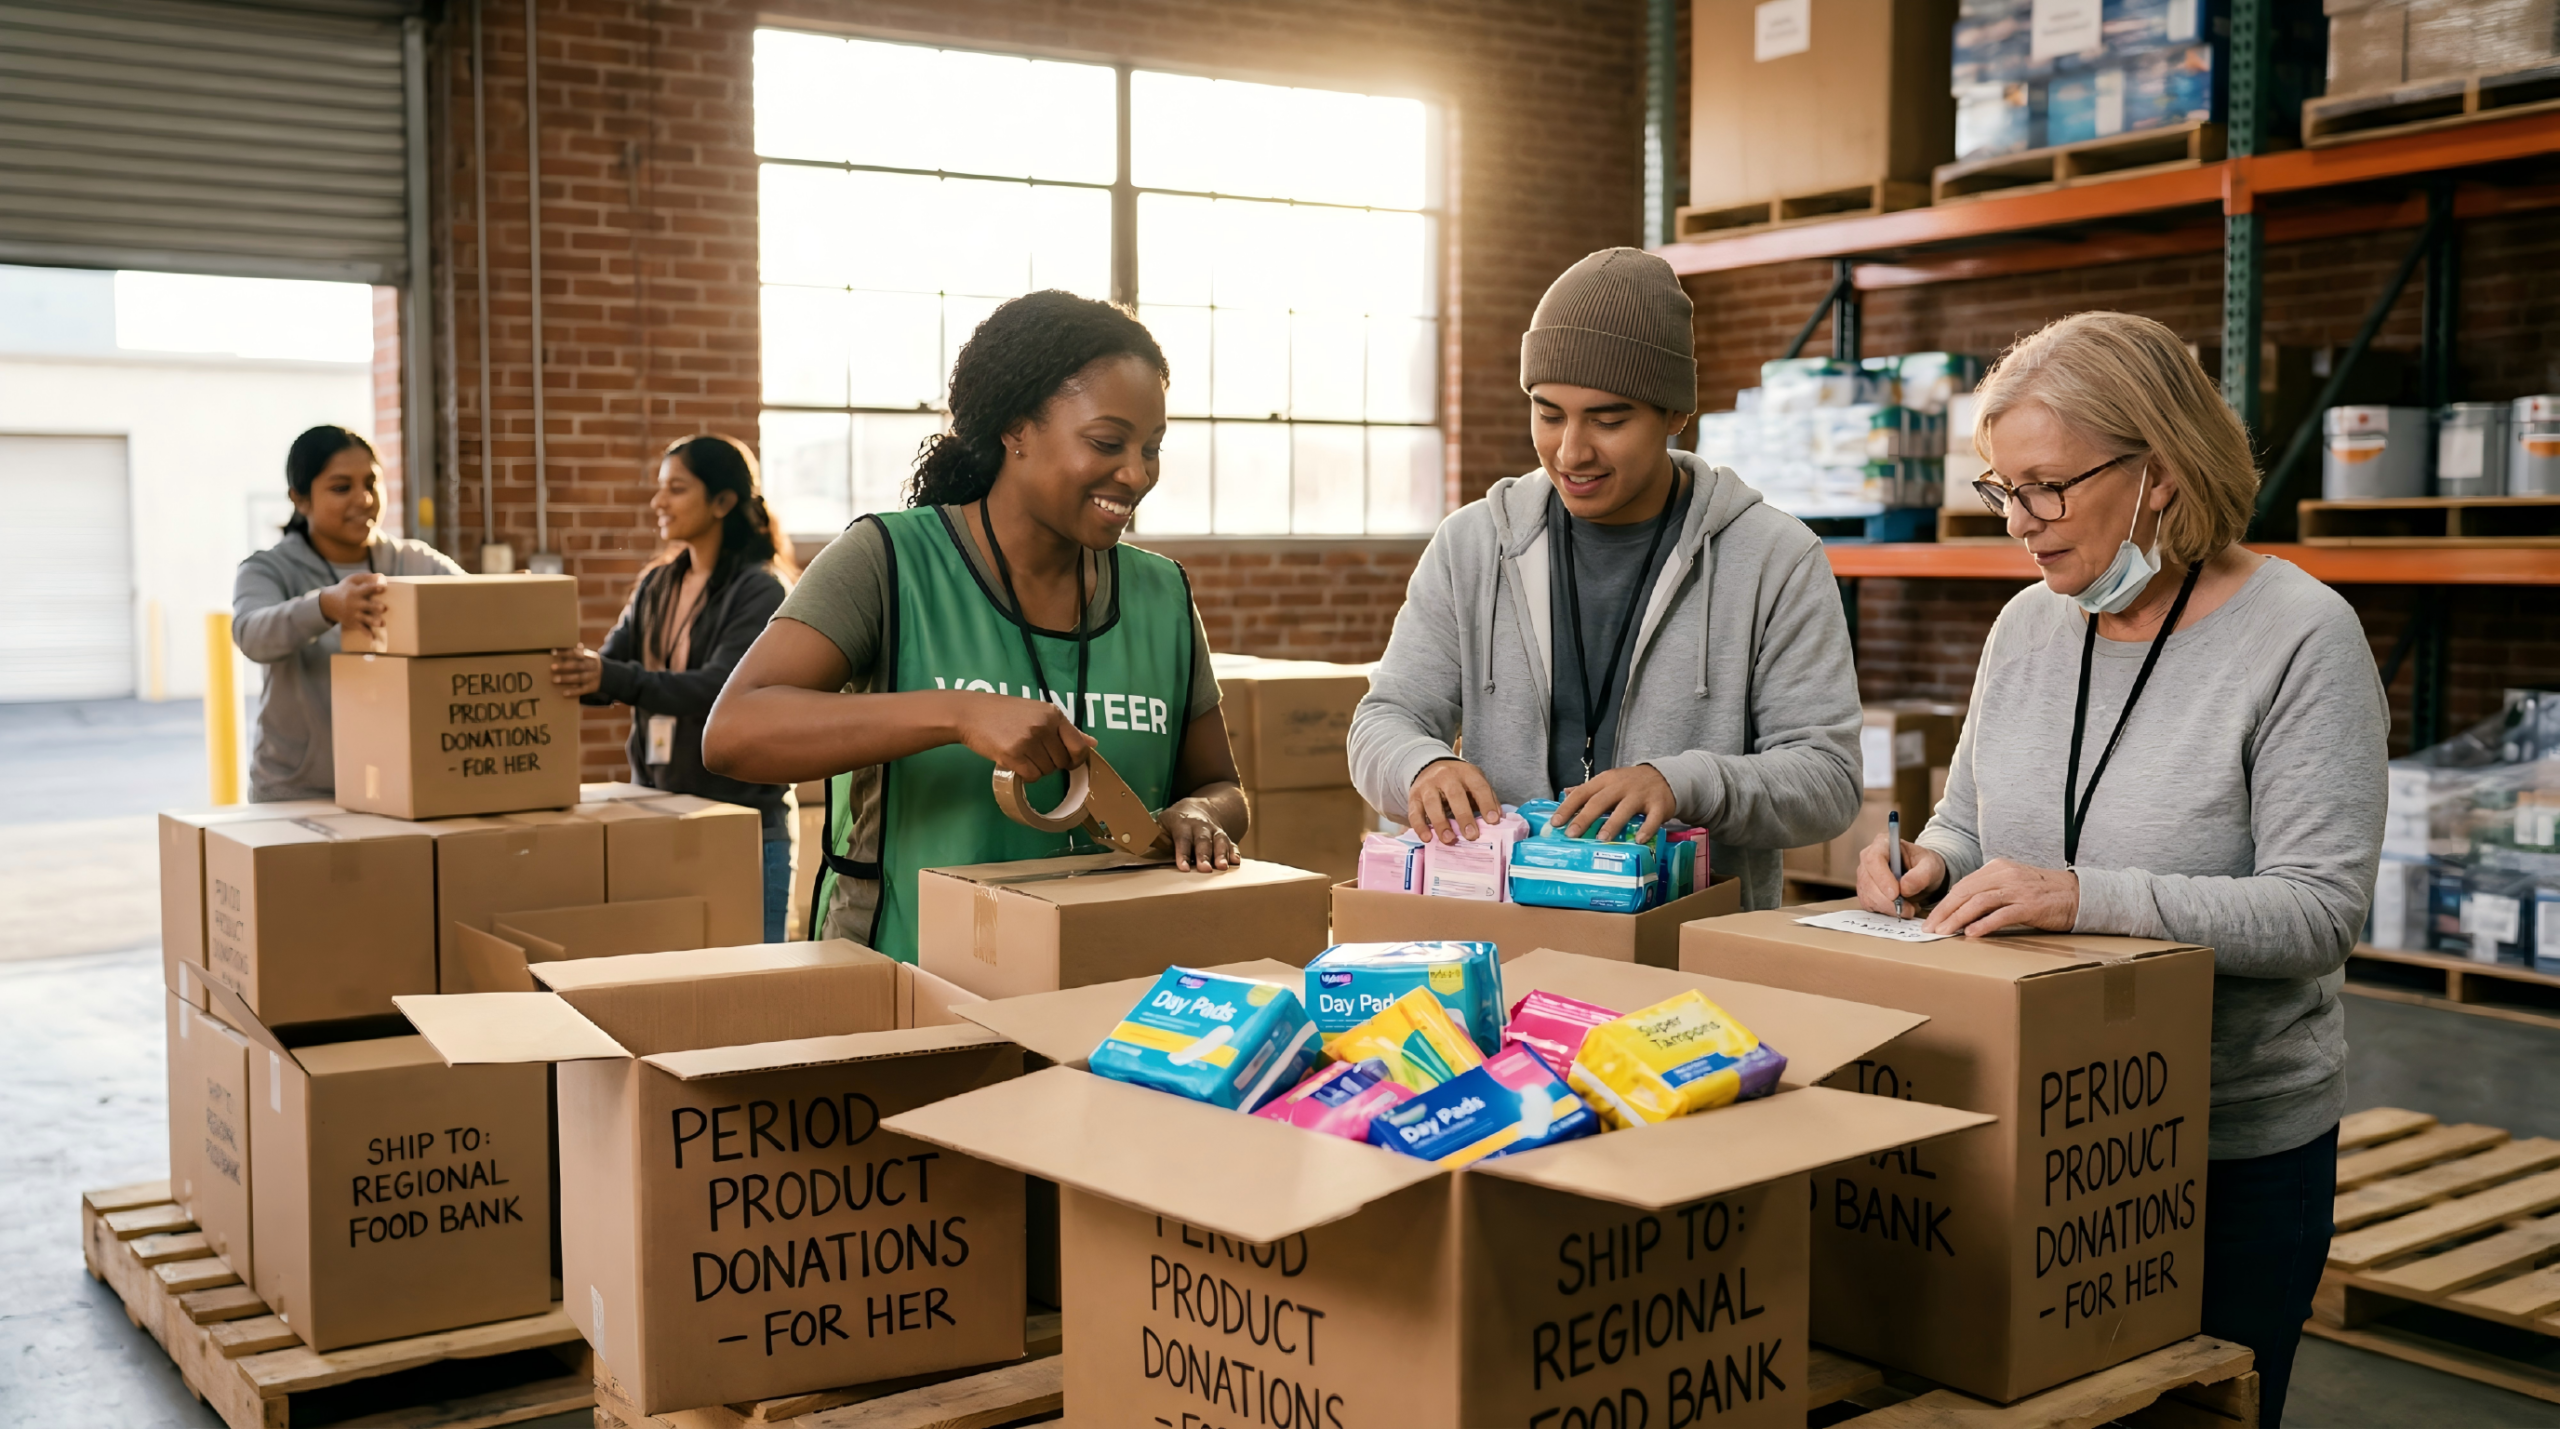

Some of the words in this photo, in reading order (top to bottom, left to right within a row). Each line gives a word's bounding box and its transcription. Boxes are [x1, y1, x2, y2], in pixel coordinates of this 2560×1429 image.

[449, 698, 540, 724] PRODUCT
[451, 671, 533, 696] PERIOD
[441, 723, 551, 752] DONATIONS
[463, 757, 498, 777] FOR
[503, 752, 541, 775] HER
[1151, 989, 1192, 1016] Day
[1188, 995, 1238, 1022] Pads
[1319, 993, 1355, 1016] Day
[1360, 992, 1400, 1013] Pad
[672, 1092, 880, 1169] PERIOD
[1400, 1117, 1440, 1144] Day
[1435, 1096, 1487, 1125] Pads
[2041, 1051, 2168, 1137] PERIOD
[352, 1159, 510, 1207] REGIONAL
[367, 1132, 435, 1166] SHIP
[444, 1127, 491, 1154] TO:
[2045, 1116, 2185, 1207] PRODUCT
[350, 1211, 429, 1248] FOOD
[440, 1195, 524, 1233] BANK
[709, 1152, 940, 1232] PRODUCT
[1835, 1178, 1956, 1257] BANK
[2036, 1179, 2196, 1279] DONATIONS
[692, 1216, 970, 1302] DONATIONS
[1557, 1216, 1661, 1295] SHIP
[1676, 1201, 1745, 1261] TO:
[764, 1304, 850, 1356] FOR
[866, 1287, 957, 1338] HER
[1151, 1254, 1326, 1366] PRODUCT
[1533, 1267, 1765, 1390] REGIONAL
[2065, 1272, 2117, 1329] FOR
[2125, 1250, 2179, 1305] HER
[1142, 1325, 1345, 1429] DONATIONS
[1668, 1338, 1787, 1429] BANK
